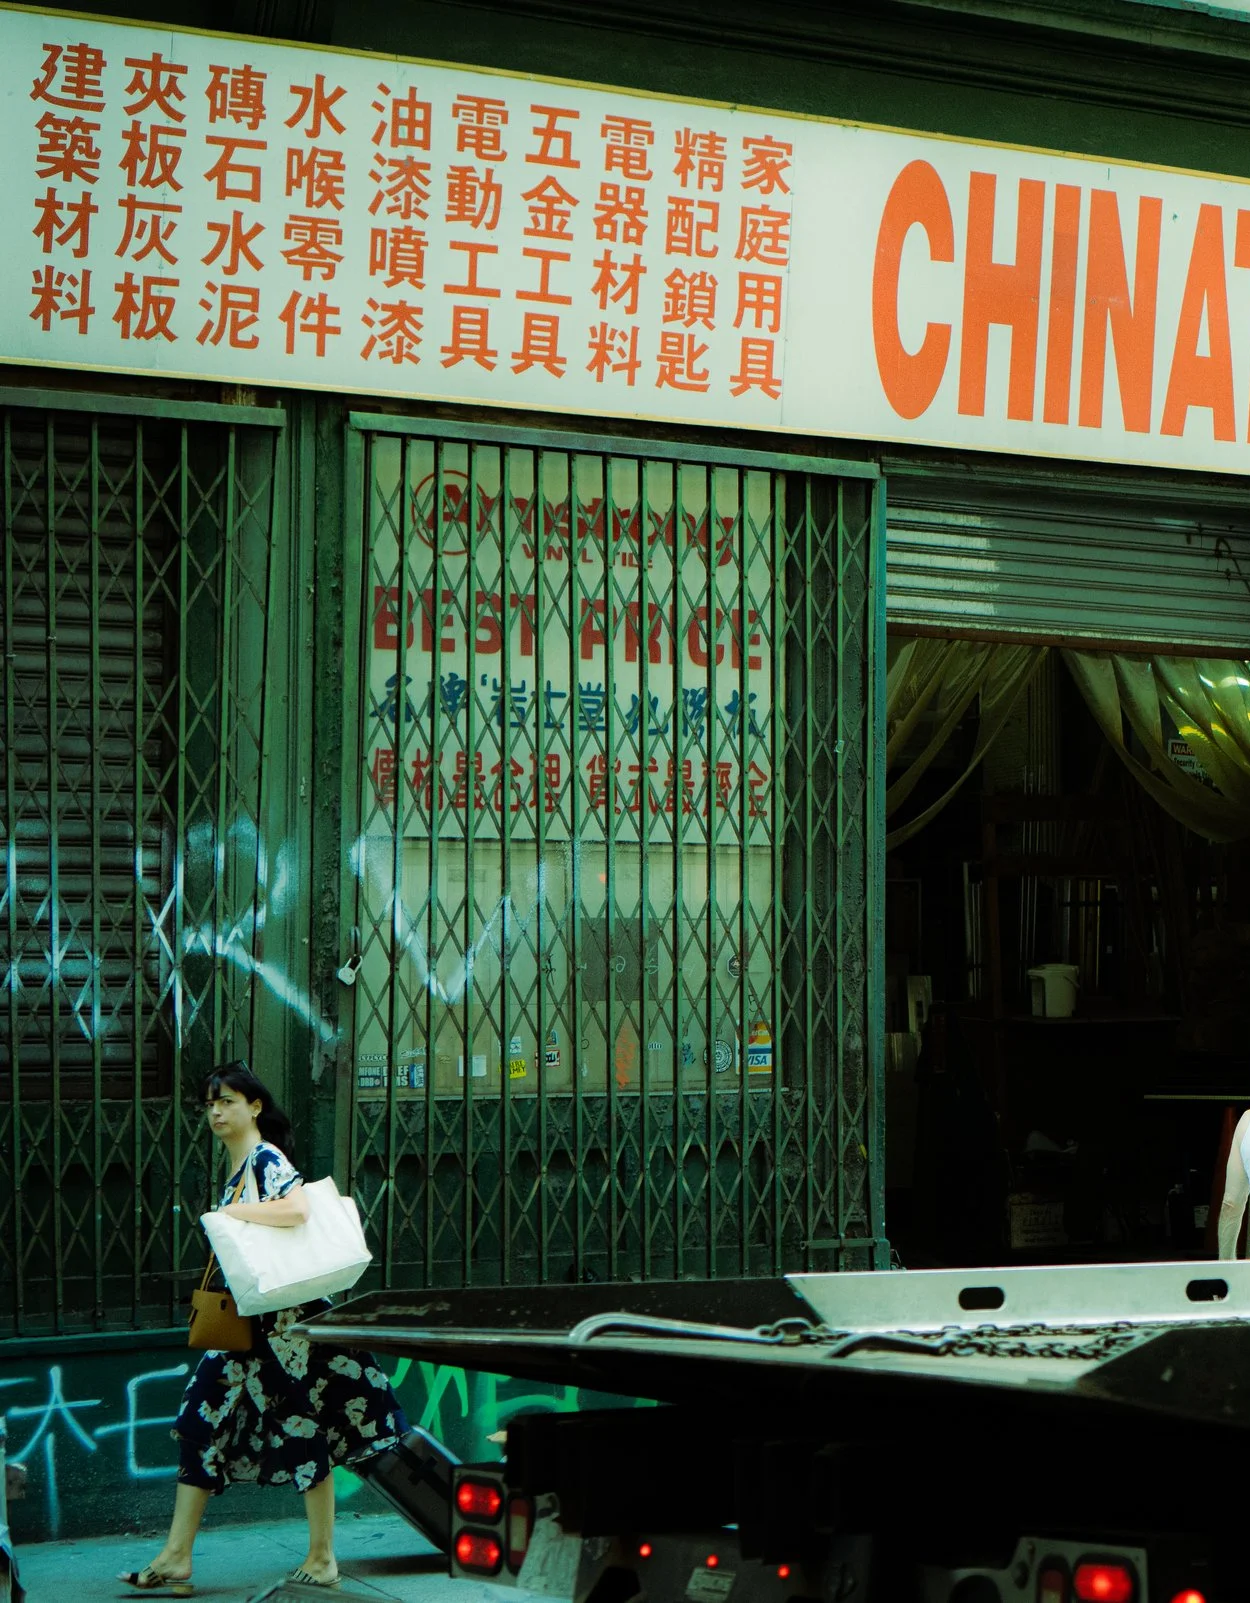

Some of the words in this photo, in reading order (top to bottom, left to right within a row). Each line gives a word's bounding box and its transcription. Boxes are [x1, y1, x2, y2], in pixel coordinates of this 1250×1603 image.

[30, 43, 106, 335] 建築材料
[114, 52, 188, 343] 夾板灰板
[198, 64, 267, 349] 磚石水泥
[279, 74, 347, 358] 水喉零件
[361, 83, 432, 365] 油漆噴漆
[441, 94, 509, 371] 電動工具
[512, 105, 580, 379] 五金工具
[587, 115, 655, 386] 電器材料
[656, 129, 726, 393] 精配鎖匙
[730, 135, 793, 400] 家庭用具
[374, 585, 545, 657] BEST
[522, 543, 593, 564] VINL
